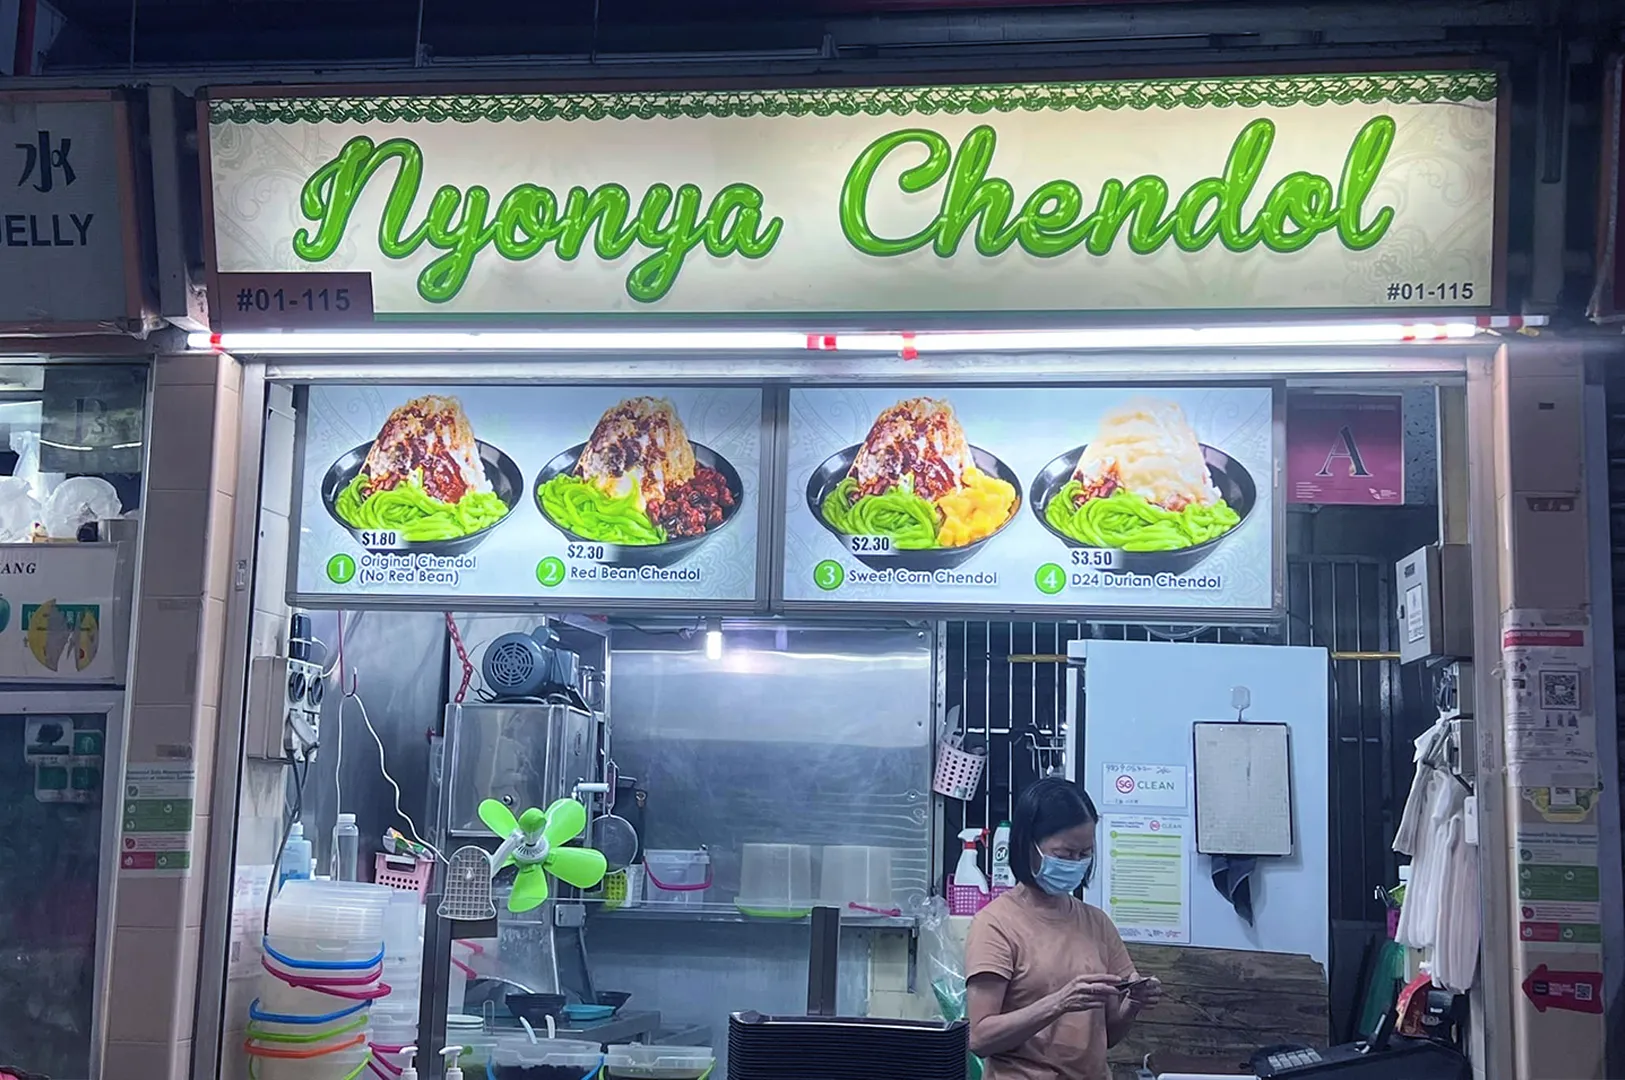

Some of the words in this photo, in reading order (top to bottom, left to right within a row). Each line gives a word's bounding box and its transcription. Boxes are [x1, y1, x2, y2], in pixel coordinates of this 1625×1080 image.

[15, 131, 77, 193] 水
[292, 135, 784, 303] Nyonya
[839, 114, 1397, 259] Chendol
[0, 213, 94, 247] ELLY
[1386, 282, 1474, 300] #01-115
[236, 287, 350, 312] #01-115
[1314, 425, 1375, 478] A
[361, 531, 397, 547] $1.80
[851, 536, 890, 552] $2.30
[566, 544, 604, 560] $2.30
[1070, 550, 1113, 566] $3.50
[0, 562, 37, 574] ANG
[360, 554, 415, 570] Original
[416, 555, 477, 569] Chendol
[359, 570, 384, 584] (No
[388, 570, 415, 583] Red
[418, 570, 460, 585] Bean)
[543, 562, 557, 581] 2
[570, 566, 597, 578] Red
[600, 567, 637, 579] Bean
[639, 567, 701, 580] Chendol
[822, 565, 836, 585] 3
[849, 569, 894, 582] Sweet
[895, 570, 931, 584] Corn
[934, 571, 998, 585] Chendol
[1042, 569, 1058, 588] 4
[1071, 573, 1100, 586] D24
[1103, 573, 1152, 587] Durian
[1155, 574, 1222, 588] Chendol
[1118, 779, 1132, 789] SG
[1137, 781, 1175, 790] CLEAN
